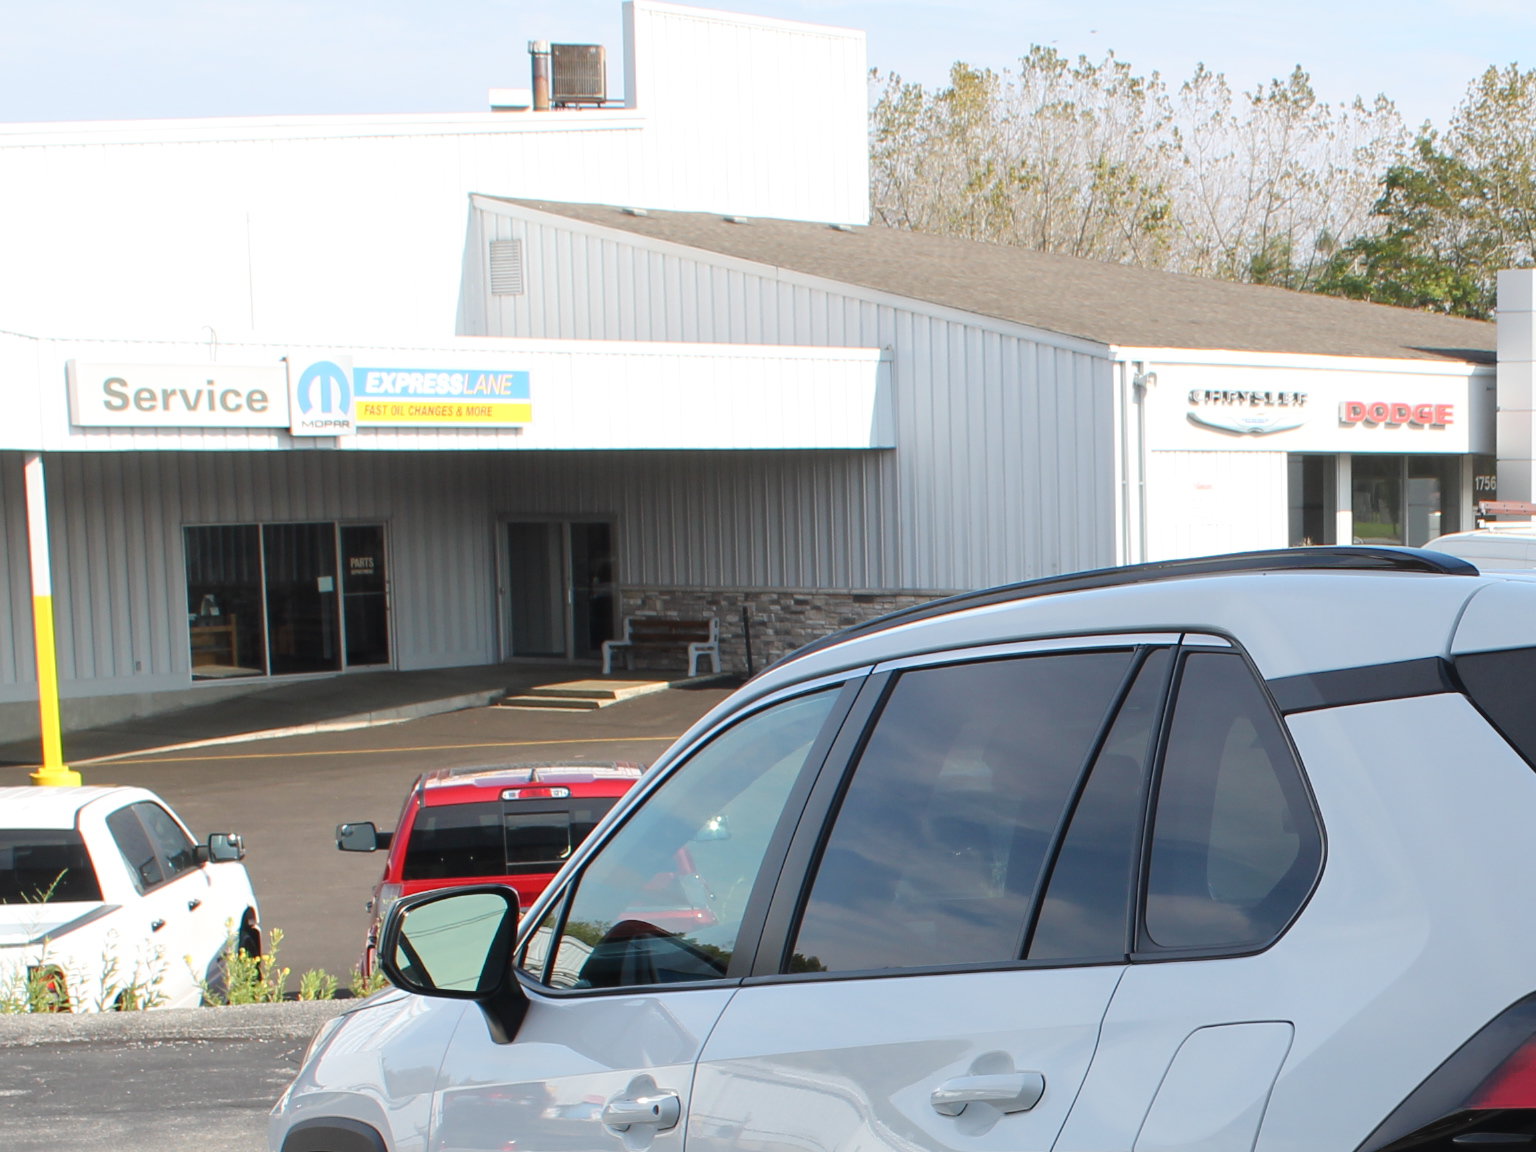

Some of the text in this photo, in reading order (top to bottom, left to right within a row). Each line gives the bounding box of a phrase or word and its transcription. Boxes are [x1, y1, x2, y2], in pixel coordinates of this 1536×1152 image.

[102, 377, 269, 412] Service
[364, 406, 493, 417] FAST OIL CHANGES & MORE
[1339, 400, 1454, 426] DODGE
[301, 420, 350, 429] MOPAR
[1475, 476, 1497, 491] 1756
[350, 557, 374, 569] PARTS
